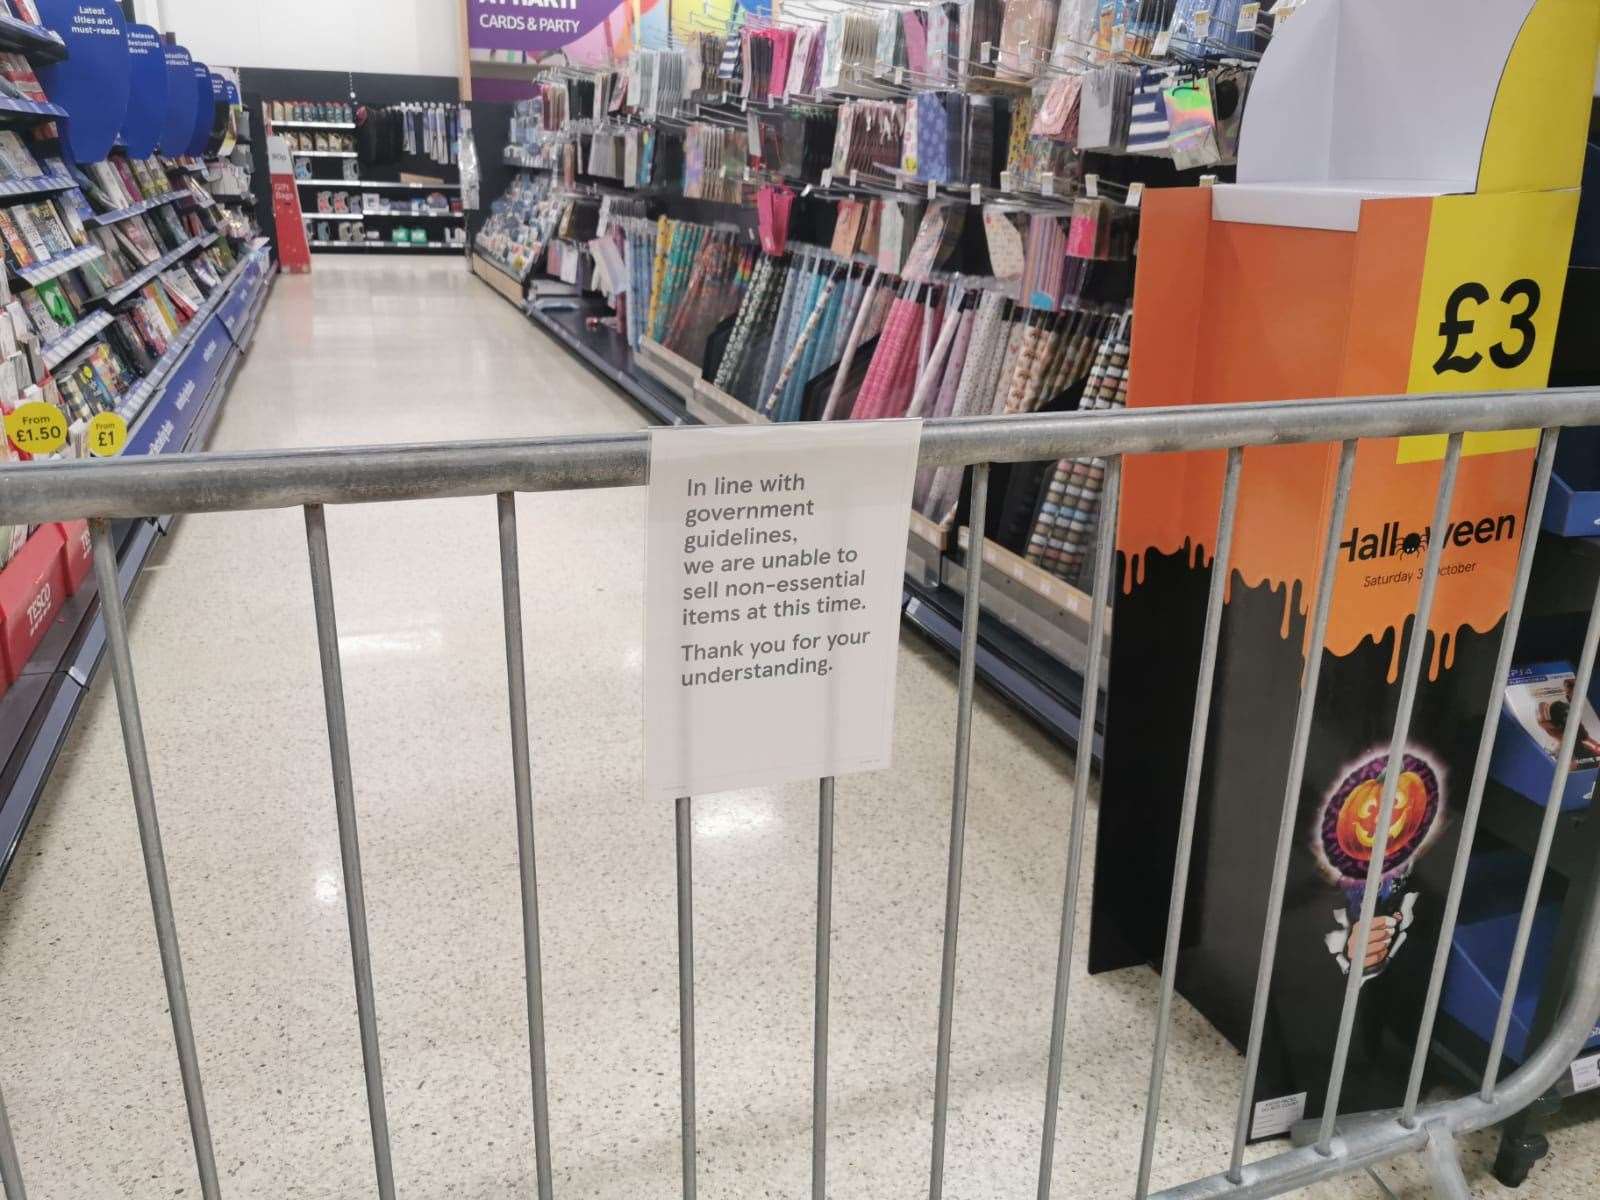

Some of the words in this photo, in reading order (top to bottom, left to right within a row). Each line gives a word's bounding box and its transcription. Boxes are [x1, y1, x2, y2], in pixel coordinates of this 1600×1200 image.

[74, 16, 96, 24] titles
[97, 17, 113, 25] and
[79, 6, 106, 15] Latest
[480, 14, 525, 30] CARDS
[527, 17, 537, 31] &
[540, 18, 580, 33] PARTY
[71, 26, 120, 35] must-reads
[1432, 278, 1541, 376] £3
[17, 426, 61, 442] £1.50
[22, 416, 51, 425] From
[98, 431, 115, 447] £1
[687, 478, 707, 497] In
[714, 476, 753, 495] line
[760, 473, 805, 493] with
[685, 500, 815, 528] government
[684, 527, 798, 554] guidelines,
[683, 560, 714, 575] we
[721, 557, 756, 572] are
[762, 549, 831, 569] unable
[837, 547, 858, 564] to
[1363, 571, 1414, 588] Saturday
[1437, 561, 1477, 577] ctober
[683, 581, 718, 600] sell
[725, 569, 866, 596] non-essential
[27, 582, 51, 627] TESCO
[682, 608, 740, 626] items
[746, 603, 768, 620] at
[774, 600, 811, 618] this
[816, 596, 867, 614] time.
[681, 640, 744, 661] Thank
[750, 639, 786, 659] you
[792, 633, 821, 650] for
[827, 631, 871, 651] your
[681, 657, 834, 687] understanding.
